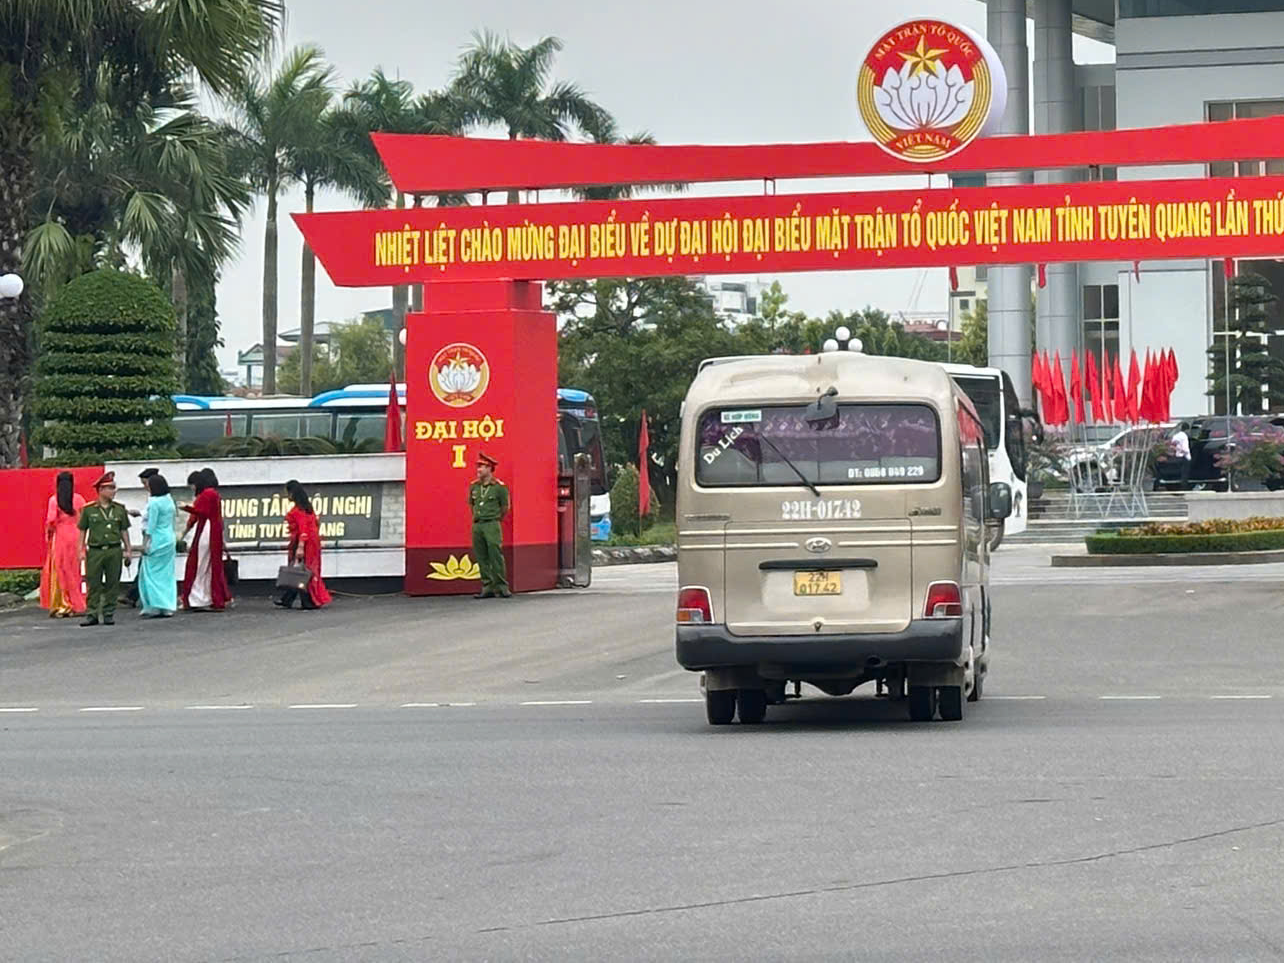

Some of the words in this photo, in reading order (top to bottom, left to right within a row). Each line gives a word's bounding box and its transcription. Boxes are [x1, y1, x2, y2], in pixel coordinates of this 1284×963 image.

[925, 133, 951, 149] NAM
[375, 223, 421, 273] NHIỆT
[424, 222, 457, 272] LIỆT
[460, 220, 503, 263] CHÀO
[506, 219, 555, 262] MỪNG
[558, 224, 586, 266] ĐẠI
[589, 209, 626, 258] BIỂU
[630, 210, 650, 257] VỀ
[653, 217, 678, 263] DỰ
[679, 220, 707, 262] ĐẠI
[711, 212, 739, 262] HỘI
[742, 218, 770, 261] ĐẠI
[774, 202, 812, 252] BIỂU
[815, 208, 851, 258] MẶT
[853, 206, 897, 257] TRẬN
[900, 198, 922, 248] TỔ
[925, 198, 970, 251] QUỐC
[973, 202, 1009, 252] VIỆT
[1012, 207, 1052, 244] NAM
[1055, 195, 1094, 242] TỈNH
[1097, 196, 1151, 241] TUYÊN
[1154, 201, 1212, 243] QUANG
[1215, 188, 1249, 237] LẦN
[415, 420, 458, 443] ĐẠI
[462, 414, 504, 442] HỘI
[452, 444, 467, 468] I
[703, 448, 721, 464] Du
[221, 499, 258, 518] UNG
[332, 496, 372, 518] NGHỊ
[228, 519, 256, 539] TỈNH
[260, 521, 289, 538] TUYÊ
[319, 522, 344, 537] ANG
